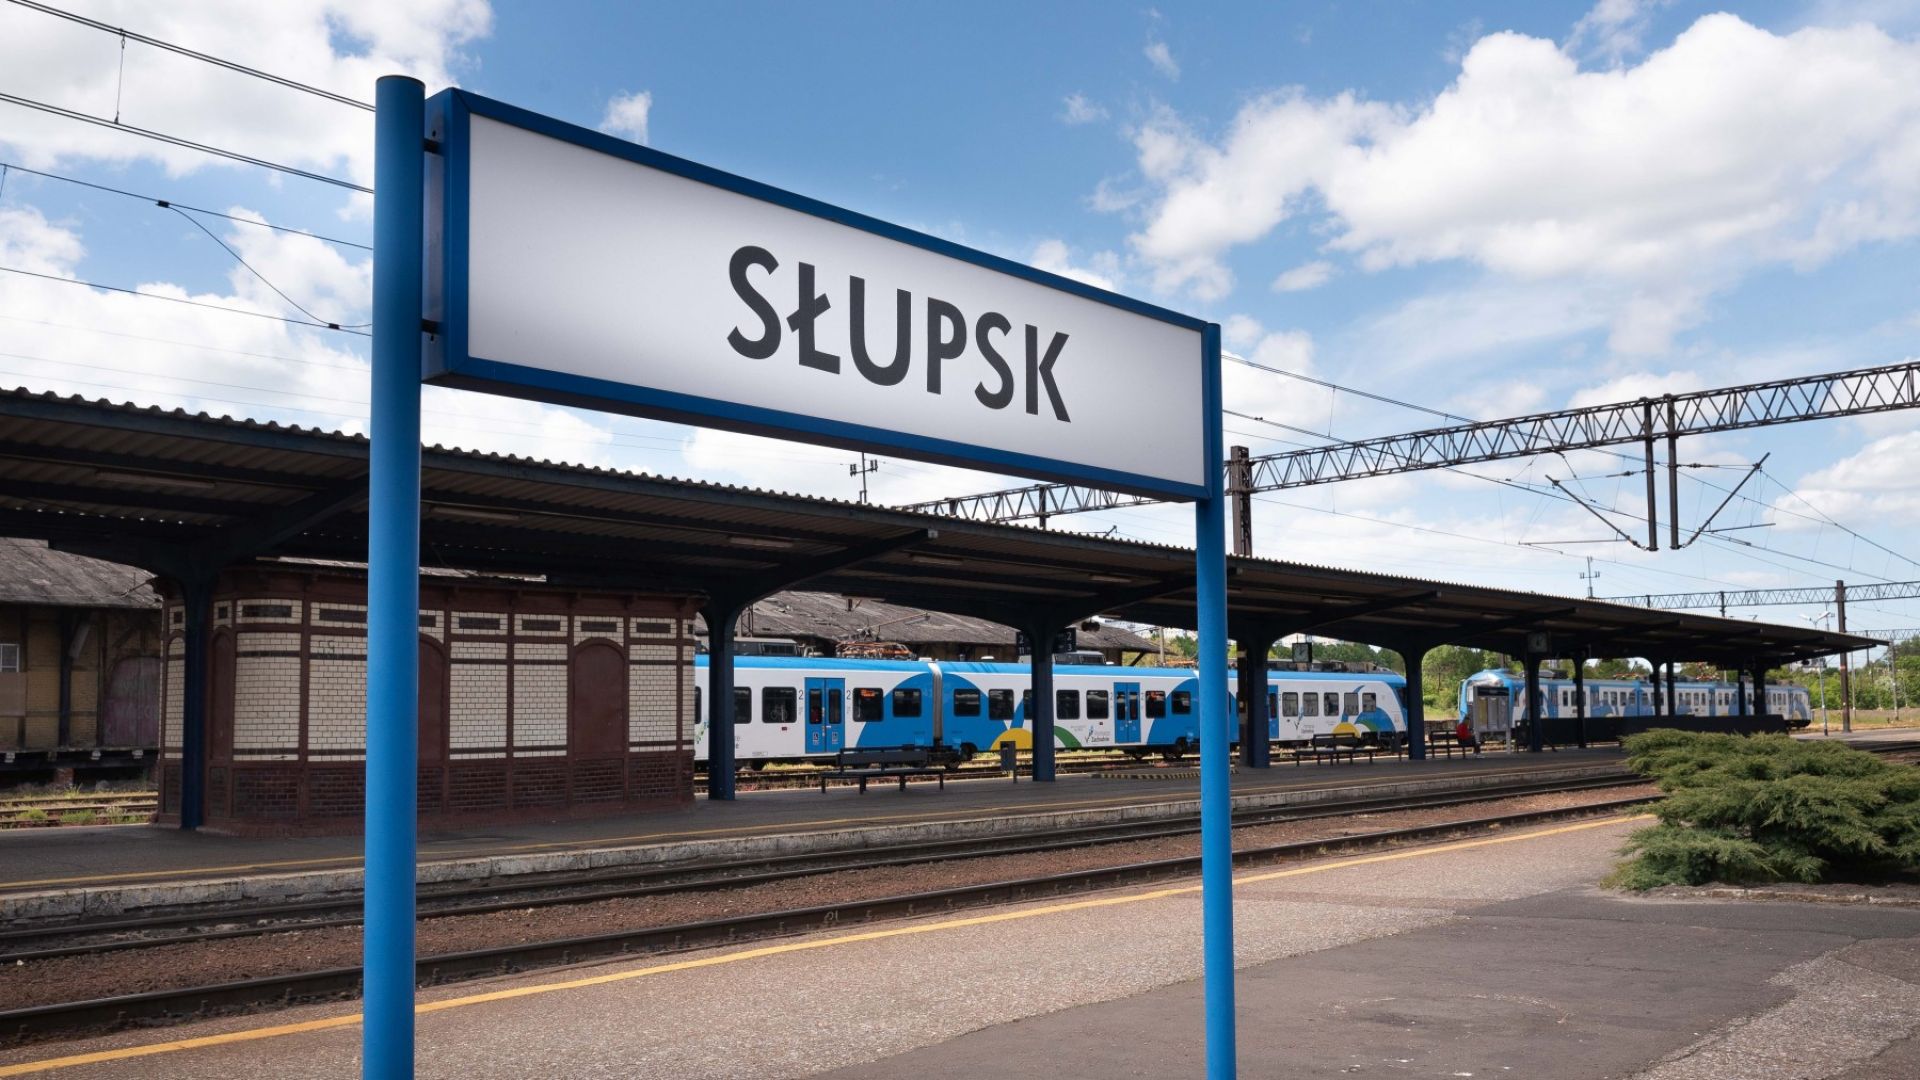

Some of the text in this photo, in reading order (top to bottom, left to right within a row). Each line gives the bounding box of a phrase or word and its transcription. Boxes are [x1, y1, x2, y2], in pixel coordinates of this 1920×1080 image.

[727, 245, 1071, 423] SŁUPSK
[1066, 631, 1072, 641] 2
[798, 689, 804, 700] 2
[846, 689, 852, 700] 2
